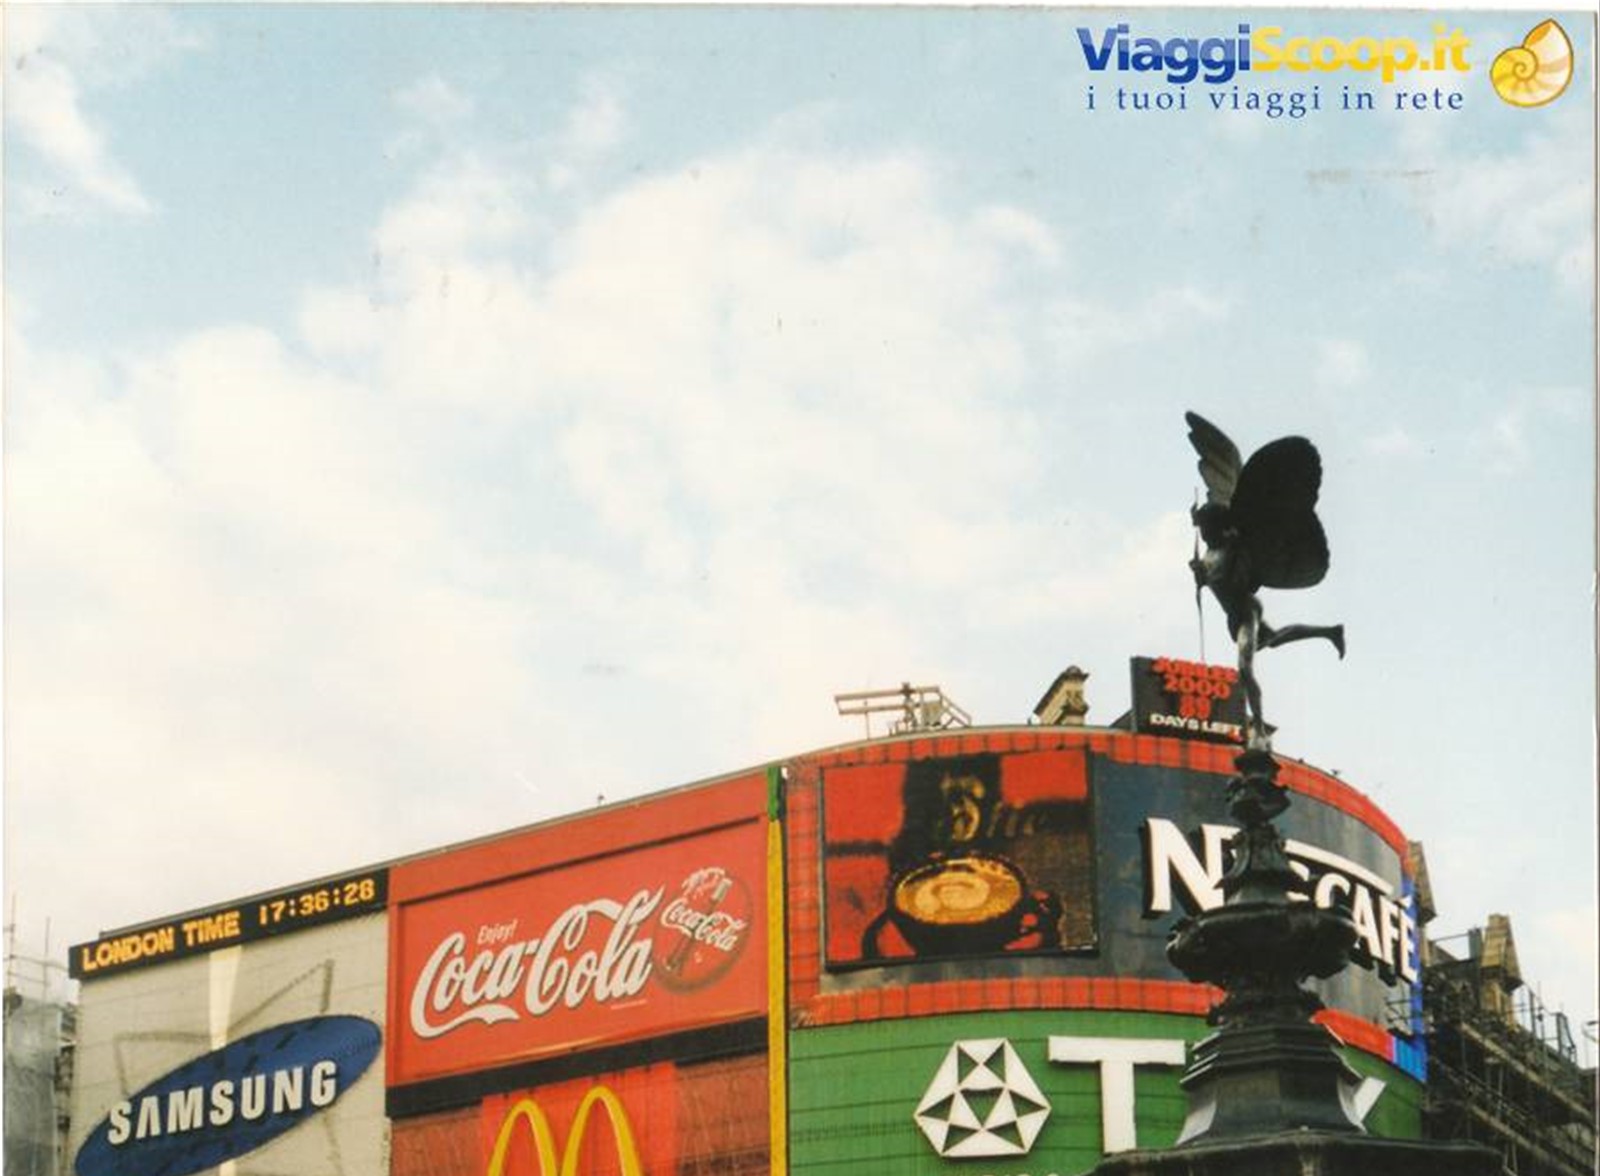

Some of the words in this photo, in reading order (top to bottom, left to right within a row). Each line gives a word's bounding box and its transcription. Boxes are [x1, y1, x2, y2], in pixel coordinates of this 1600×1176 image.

[82, 928, 174, 971] LONDON
[184, 911, 240, 946] TIME
[259, 879, 375, 925] 17:36:28
[1147, 817, 1418, 984] NCAFÉ
[410, 886, 665, 1038] Coca-Cola
[107, 1061, 337, 1145] SAMSUNG
